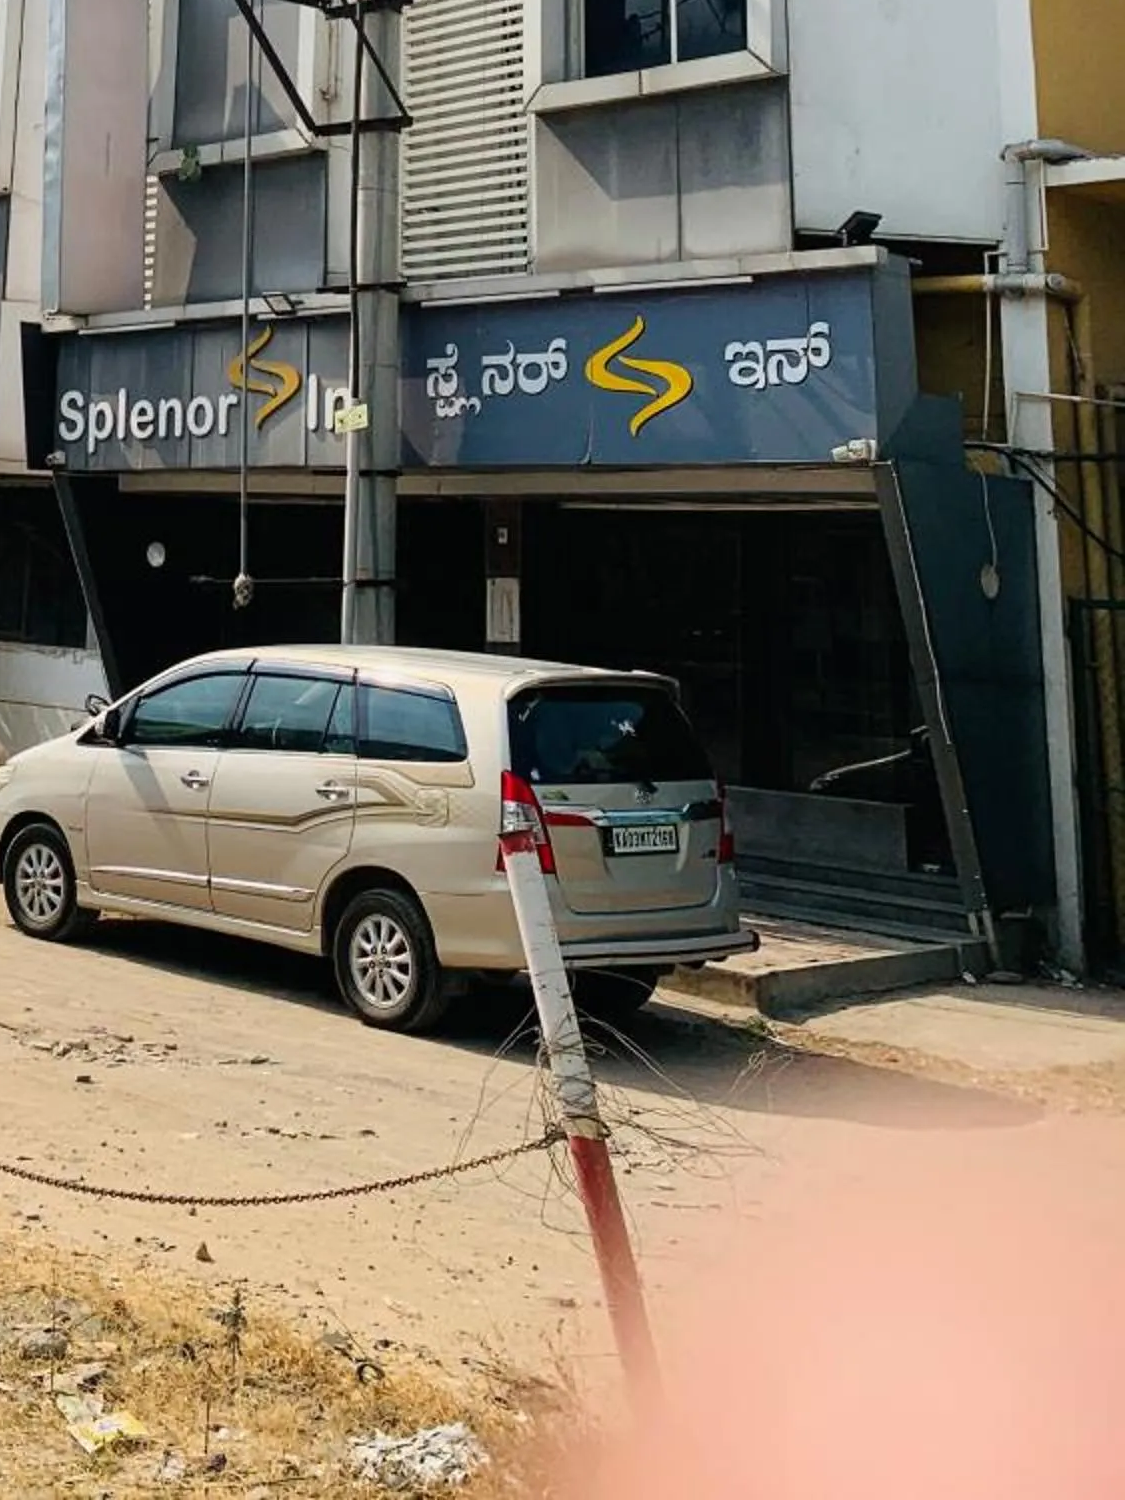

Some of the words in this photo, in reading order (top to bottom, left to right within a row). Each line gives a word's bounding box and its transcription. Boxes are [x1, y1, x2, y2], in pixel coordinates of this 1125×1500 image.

[724, 321, 830, 389] ಇನ್
[58, 388, 238, 454] Splenor
[307, 373, 353, 432] In
